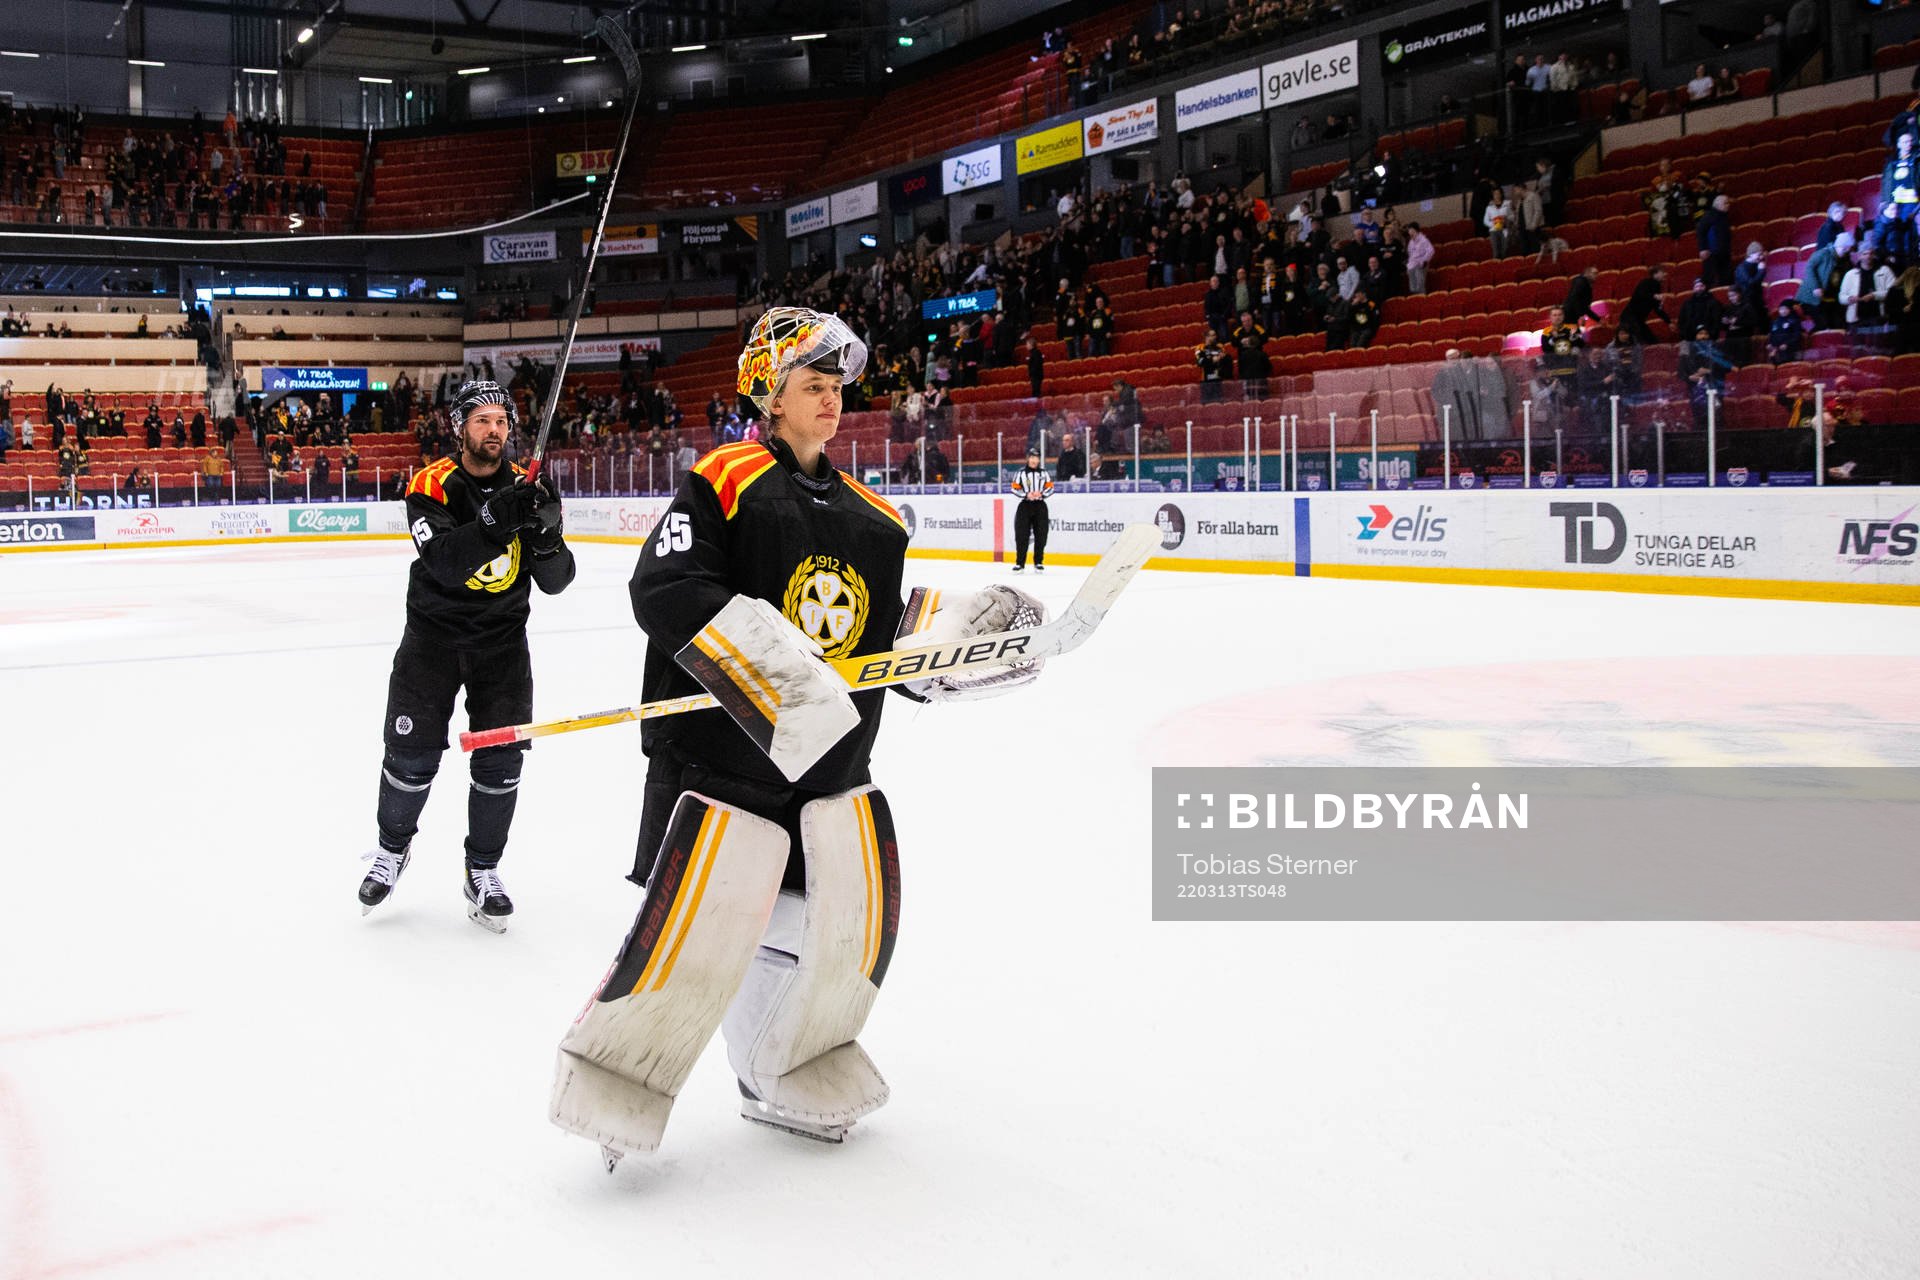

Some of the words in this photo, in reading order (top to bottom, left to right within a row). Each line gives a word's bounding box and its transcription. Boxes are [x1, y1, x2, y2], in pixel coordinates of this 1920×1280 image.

[1505, 0, 1584, 29] HAGMANS
[1404, 22, 1487, 54] GRÄVTEKNIK
[1268, 55, 1351, 101] gavle.se
[1178, 86, 1258, 117] Handelsbanken
[1036, 135, 1079, 155] Ramudden
[970, 160, 991, 181] SSG
[683, 225, 700, 237] Följ
[701, 226, 716, 234] oss
[717, 223, 729, 236] på
[498, 238, 549, 250] Caravan
[507, 248, 549, 259] Marine
[253, 519, 268, 528] AB
[924, 517, 937, 530] För
[939, 517, 983, 530] samhället
[1048, 518, 1058, 531] Vi
[1060, 520, 1074, 532] tar
[1076, 519, 1125, 533] matchen
[1197, 520, 1216, 535] För
[1218, 521, 1244, 535] alla
[1247, 521, 1279, 536] barn
[1392, 504, 1448, 542] elis
[1550, 501, 1628, 565] TD
[1838, 522, 1919, 557] NFS
[1635, 535, 1692, 550] TUNGA
[1697, 536, 1756, 551] DELAR
[1356, 546, 1369, 555] We
[1371, 547, 1409, 558] empower
[1410, 548, 1429, 558] your
[1431, 548, 1448, 559] day
[1635, 551, 1706, 568] SVERIGE
[1711, 554, 1735, 568] AB
[815, 555, 839, 572] 1912
[822, 581, 831, 596] B
[836, 616, 845, 629] F
[857, 635, 1031, 683] BAUER
[640, 848, 684, 950] BAUER
